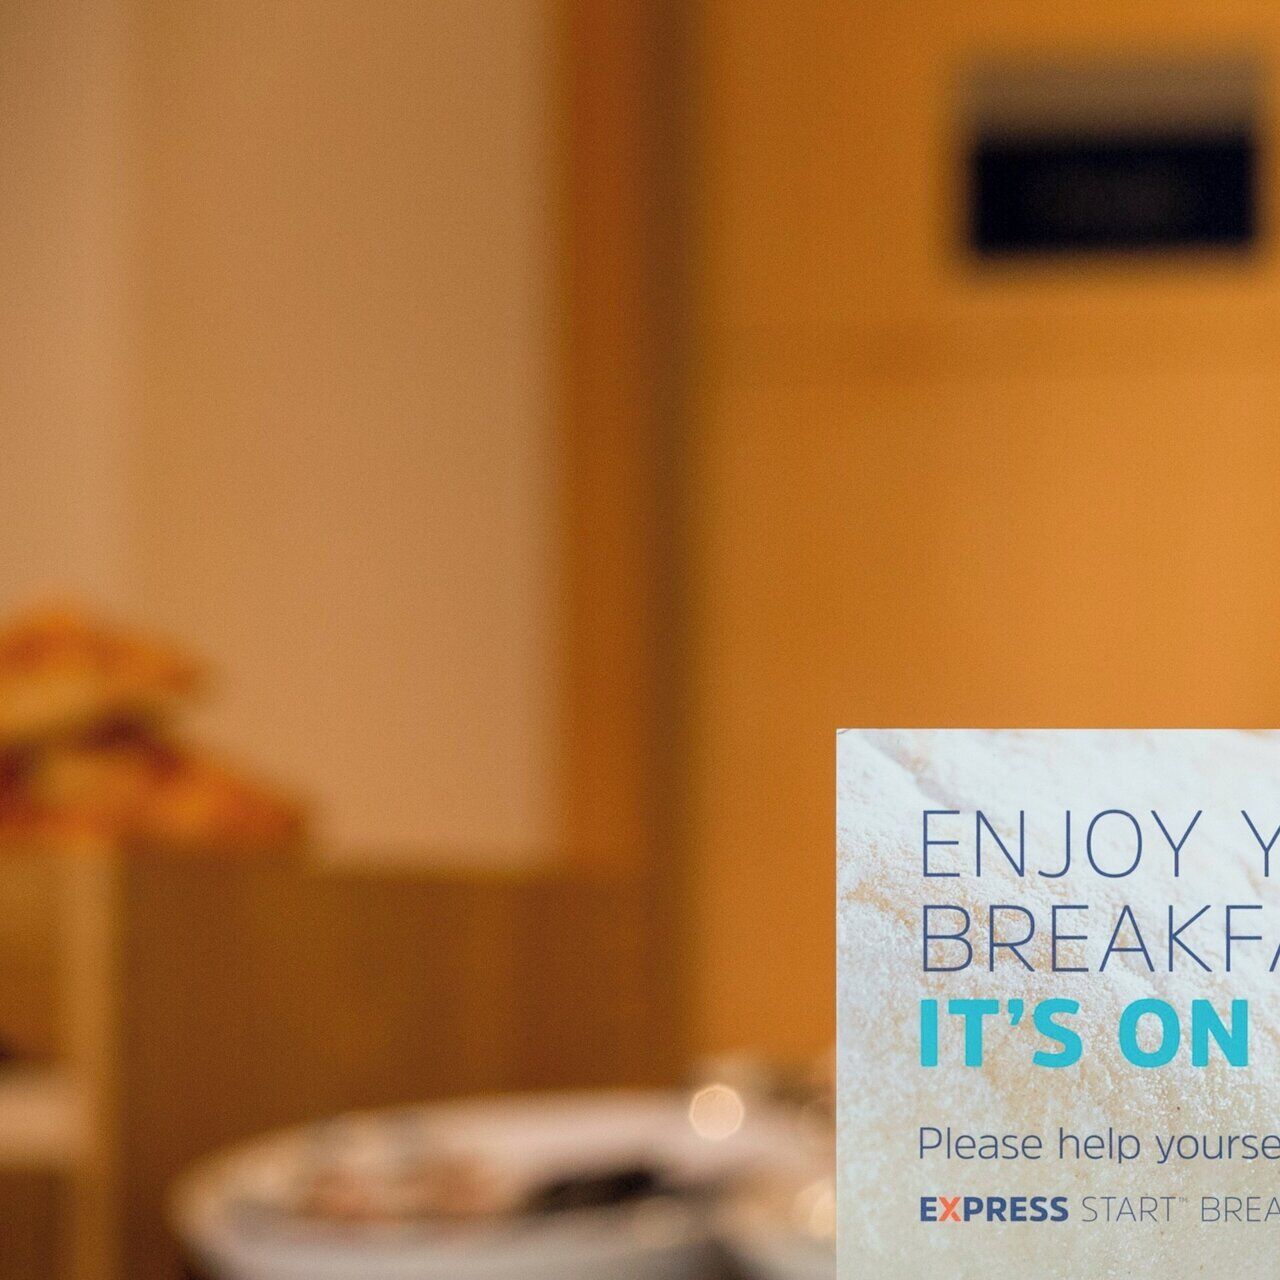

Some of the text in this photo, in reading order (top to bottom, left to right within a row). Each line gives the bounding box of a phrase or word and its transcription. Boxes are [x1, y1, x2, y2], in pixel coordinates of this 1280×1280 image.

[921, 808, 1204, 879] ENJOY
[919, 997, 1084, 1069] IT’S
[1117, 997, 1249, 1069] ON
[918, 1126, 1043, 1160] Please
[1058, 1126, 1141, 1165] help
[919, 1195, 1069, 1223] EXPRESS
